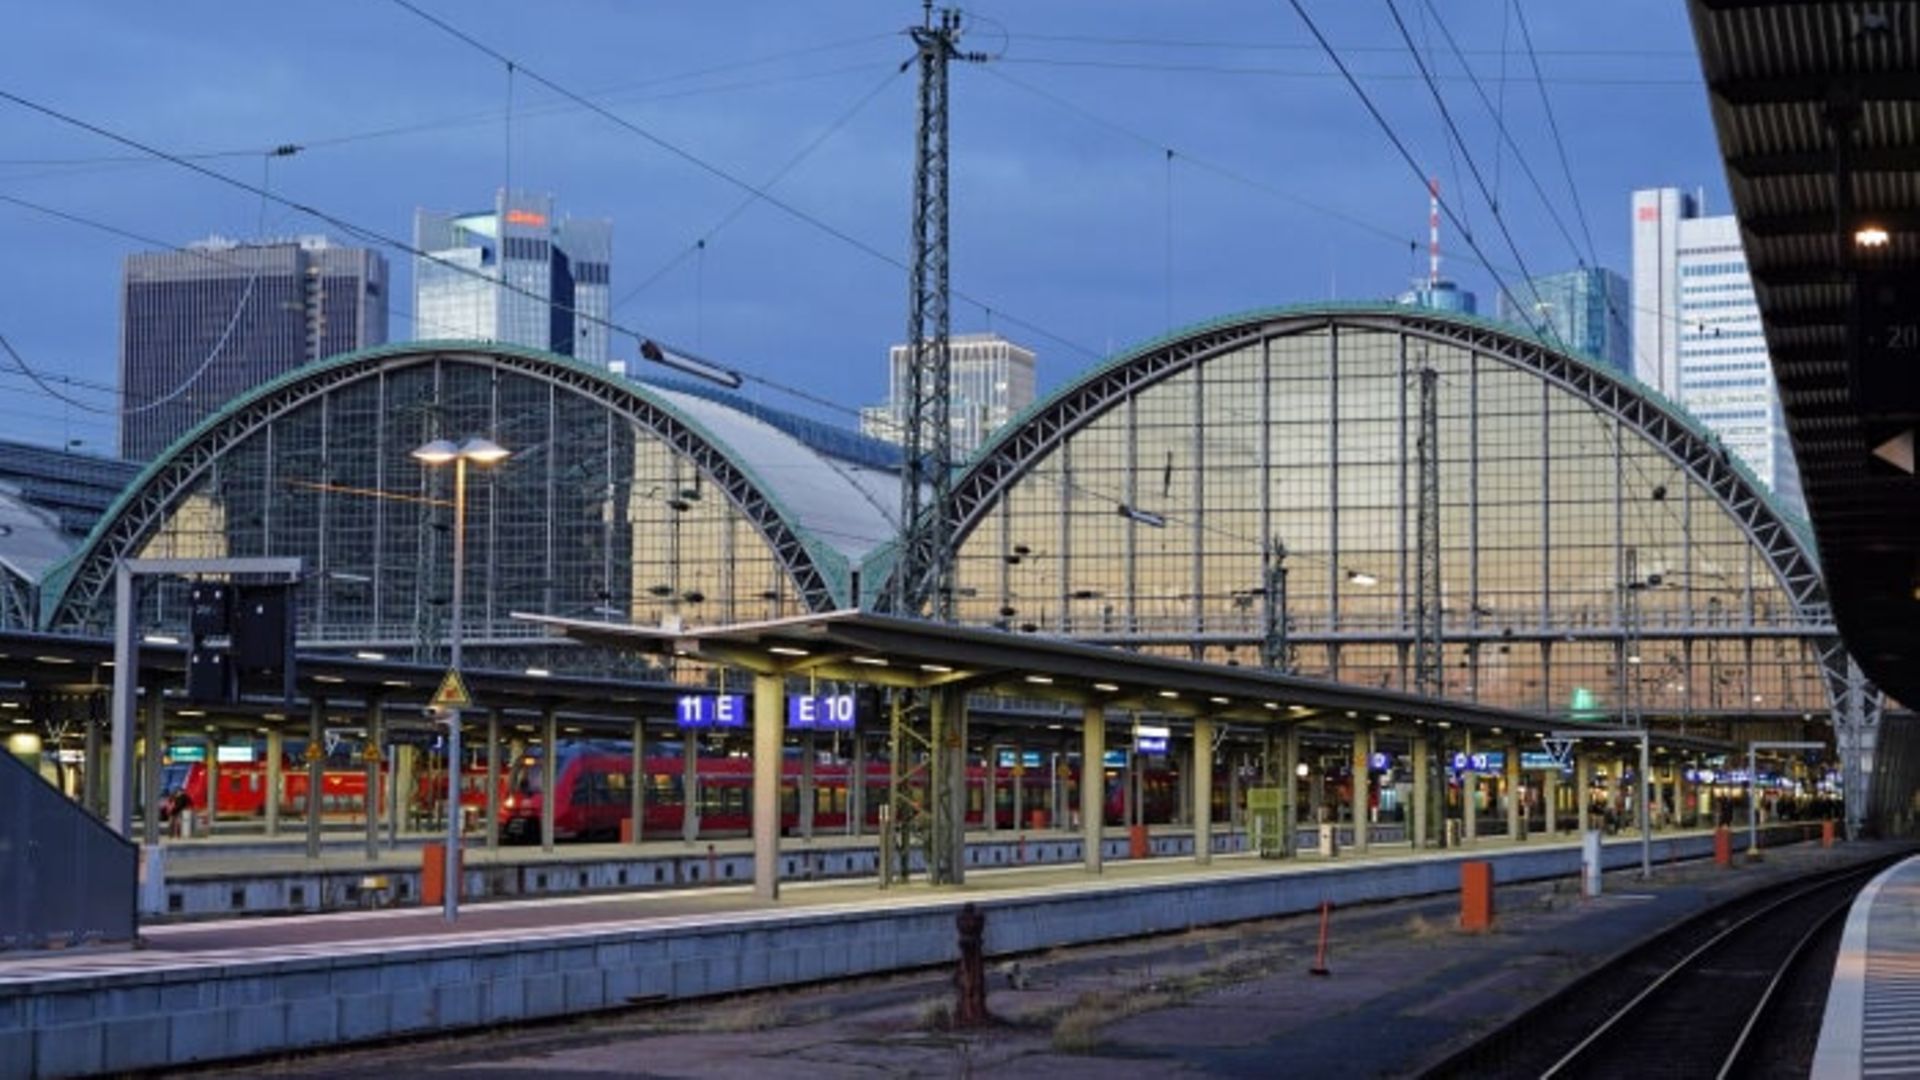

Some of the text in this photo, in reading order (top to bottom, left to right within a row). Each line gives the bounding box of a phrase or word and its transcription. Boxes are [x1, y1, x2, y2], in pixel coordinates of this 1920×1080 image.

[1887, 324, 1918, 349] 20
[680, 696, 733, 721] 11 E
[800, 696, 852, 721] E 10
